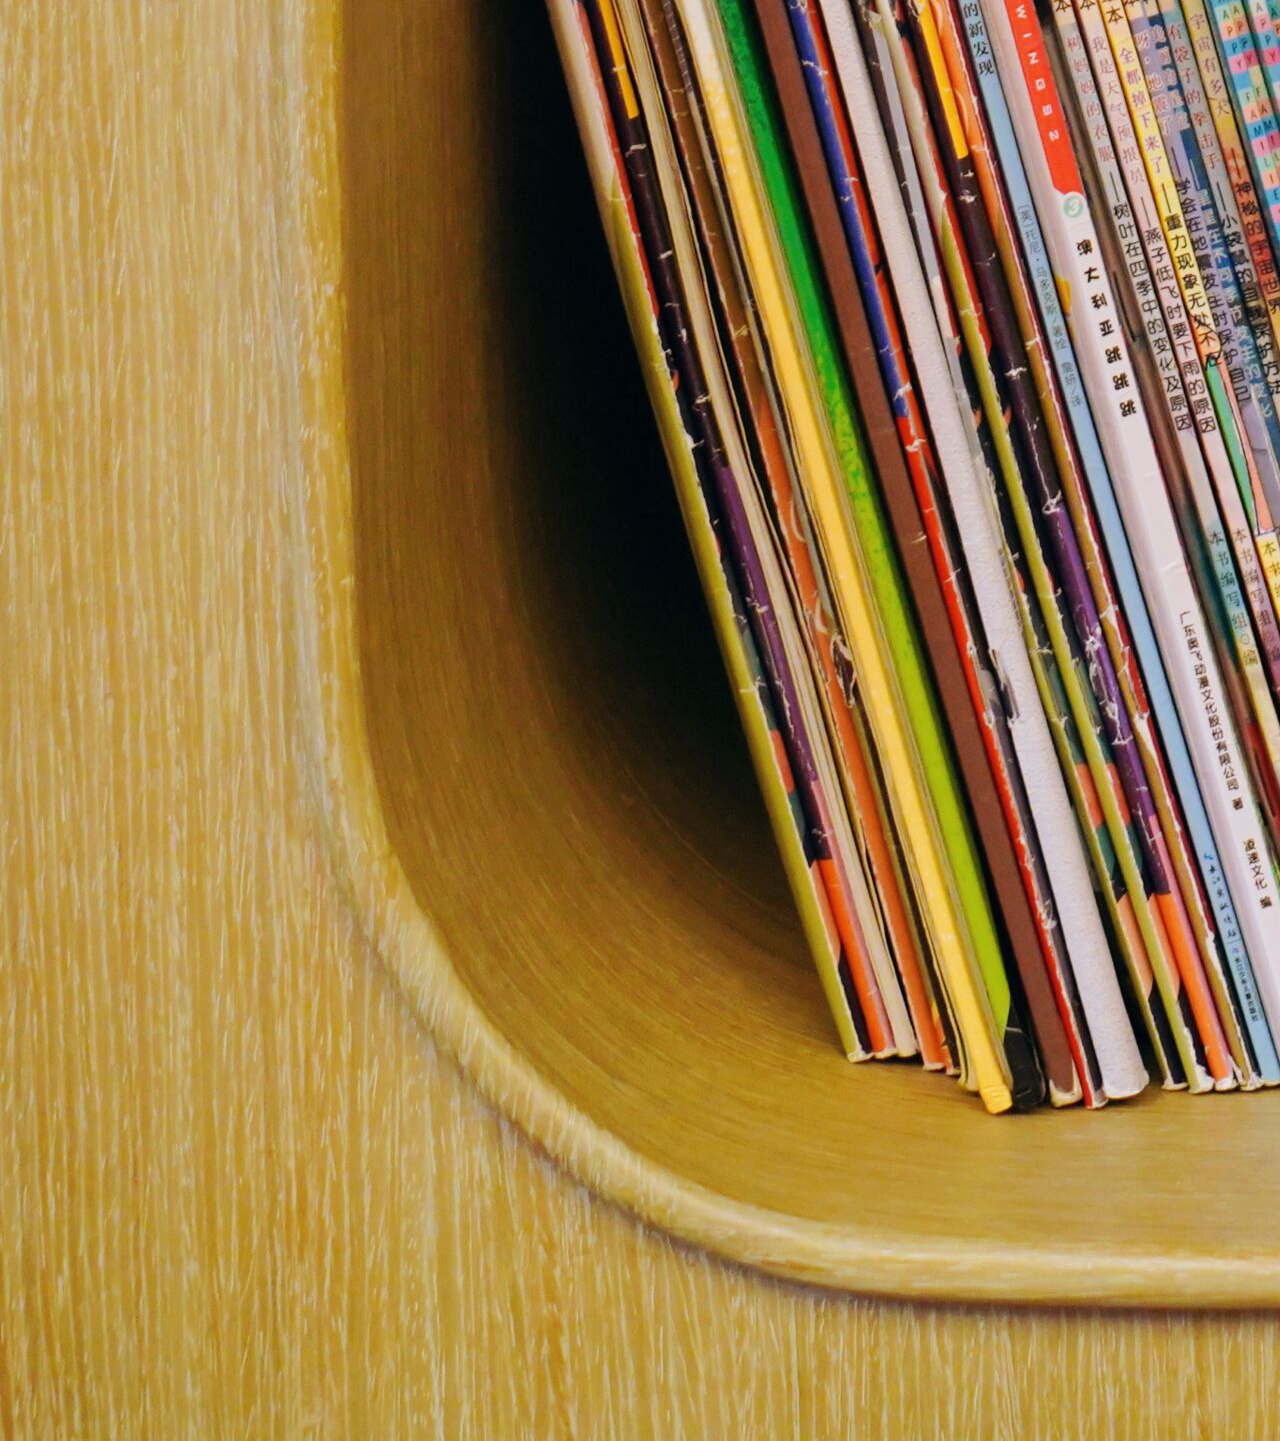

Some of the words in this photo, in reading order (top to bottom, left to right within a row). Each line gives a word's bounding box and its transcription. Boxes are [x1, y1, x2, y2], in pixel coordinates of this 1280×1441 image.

[1017, 7, 1053, 117] WINGS
[1180, 610, 1241, 791] 广东奥飞动漫文化股份有限公司
